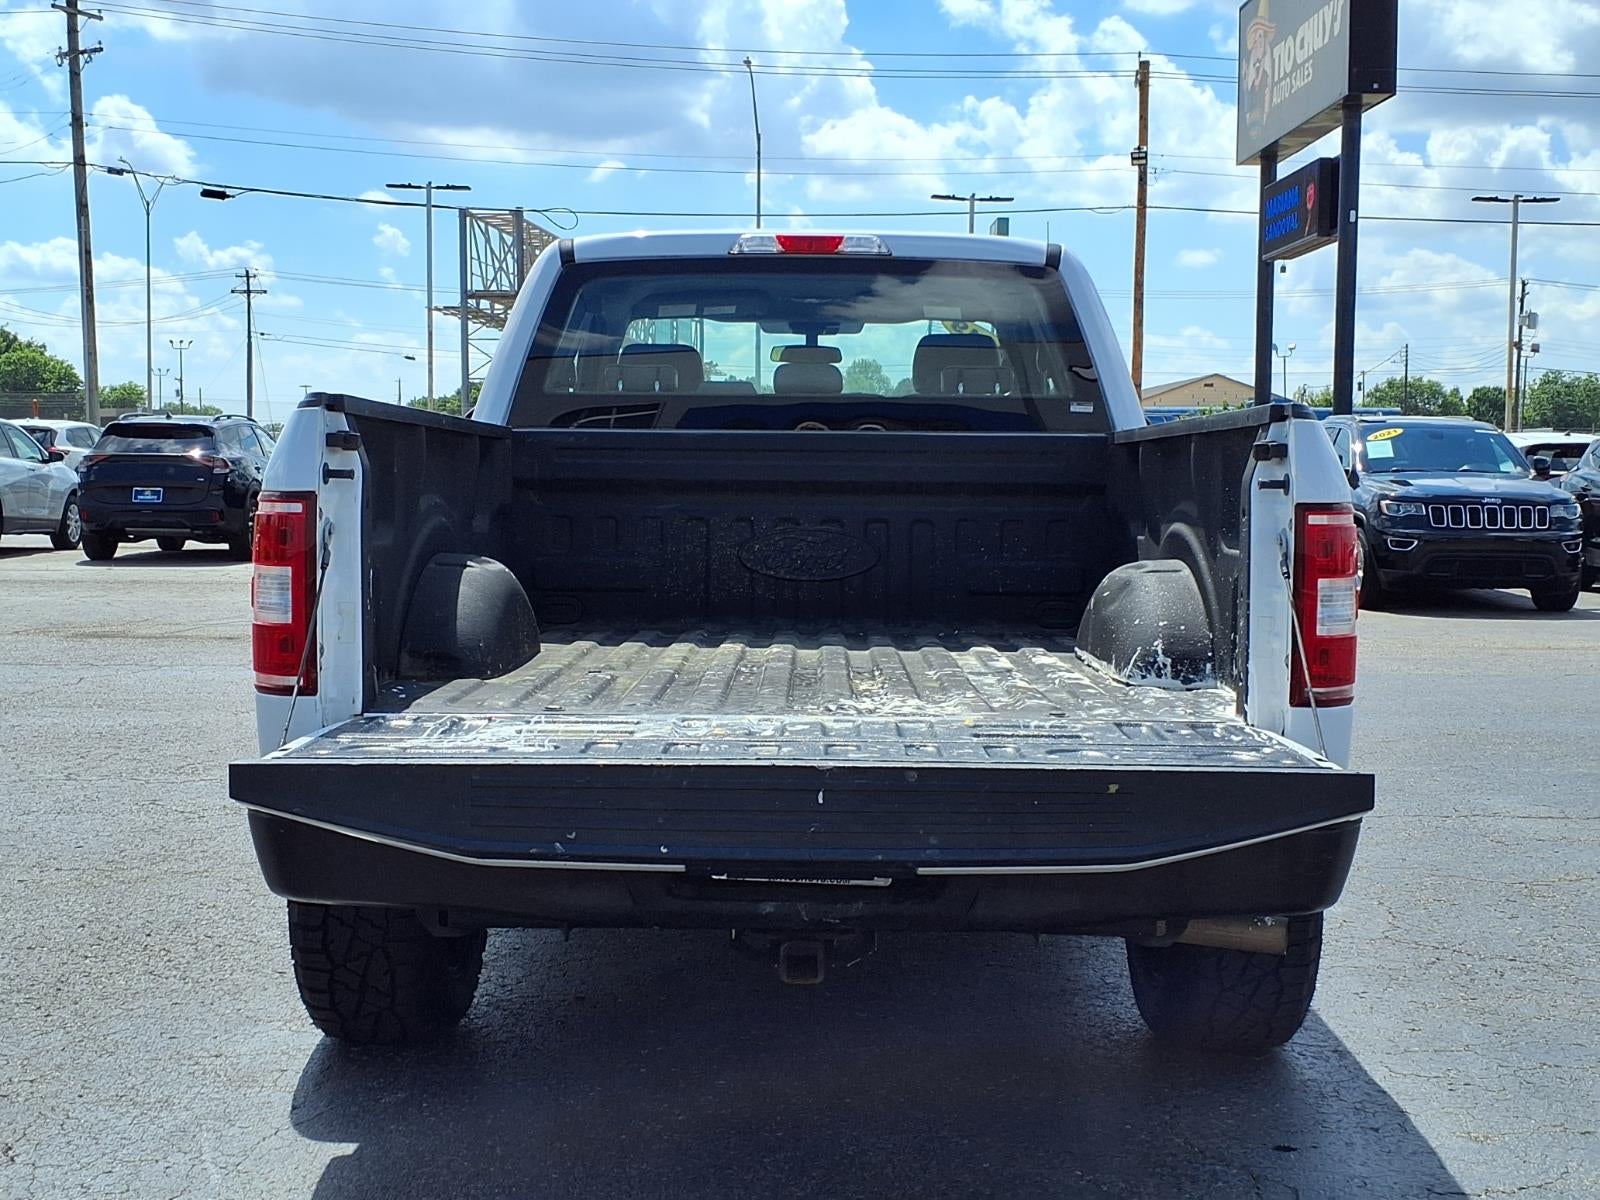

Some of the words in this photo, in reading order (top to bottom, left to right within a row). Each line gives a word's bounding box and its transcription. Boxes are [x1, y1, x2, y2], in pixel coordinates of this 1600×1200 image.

[1272, 35, 1295, 82] TIO
[1272, 85, 1290, 107] AUTO
[1291, 59, 1313, 93] SALES
[1481, 497, 1502, 505] Jeep
